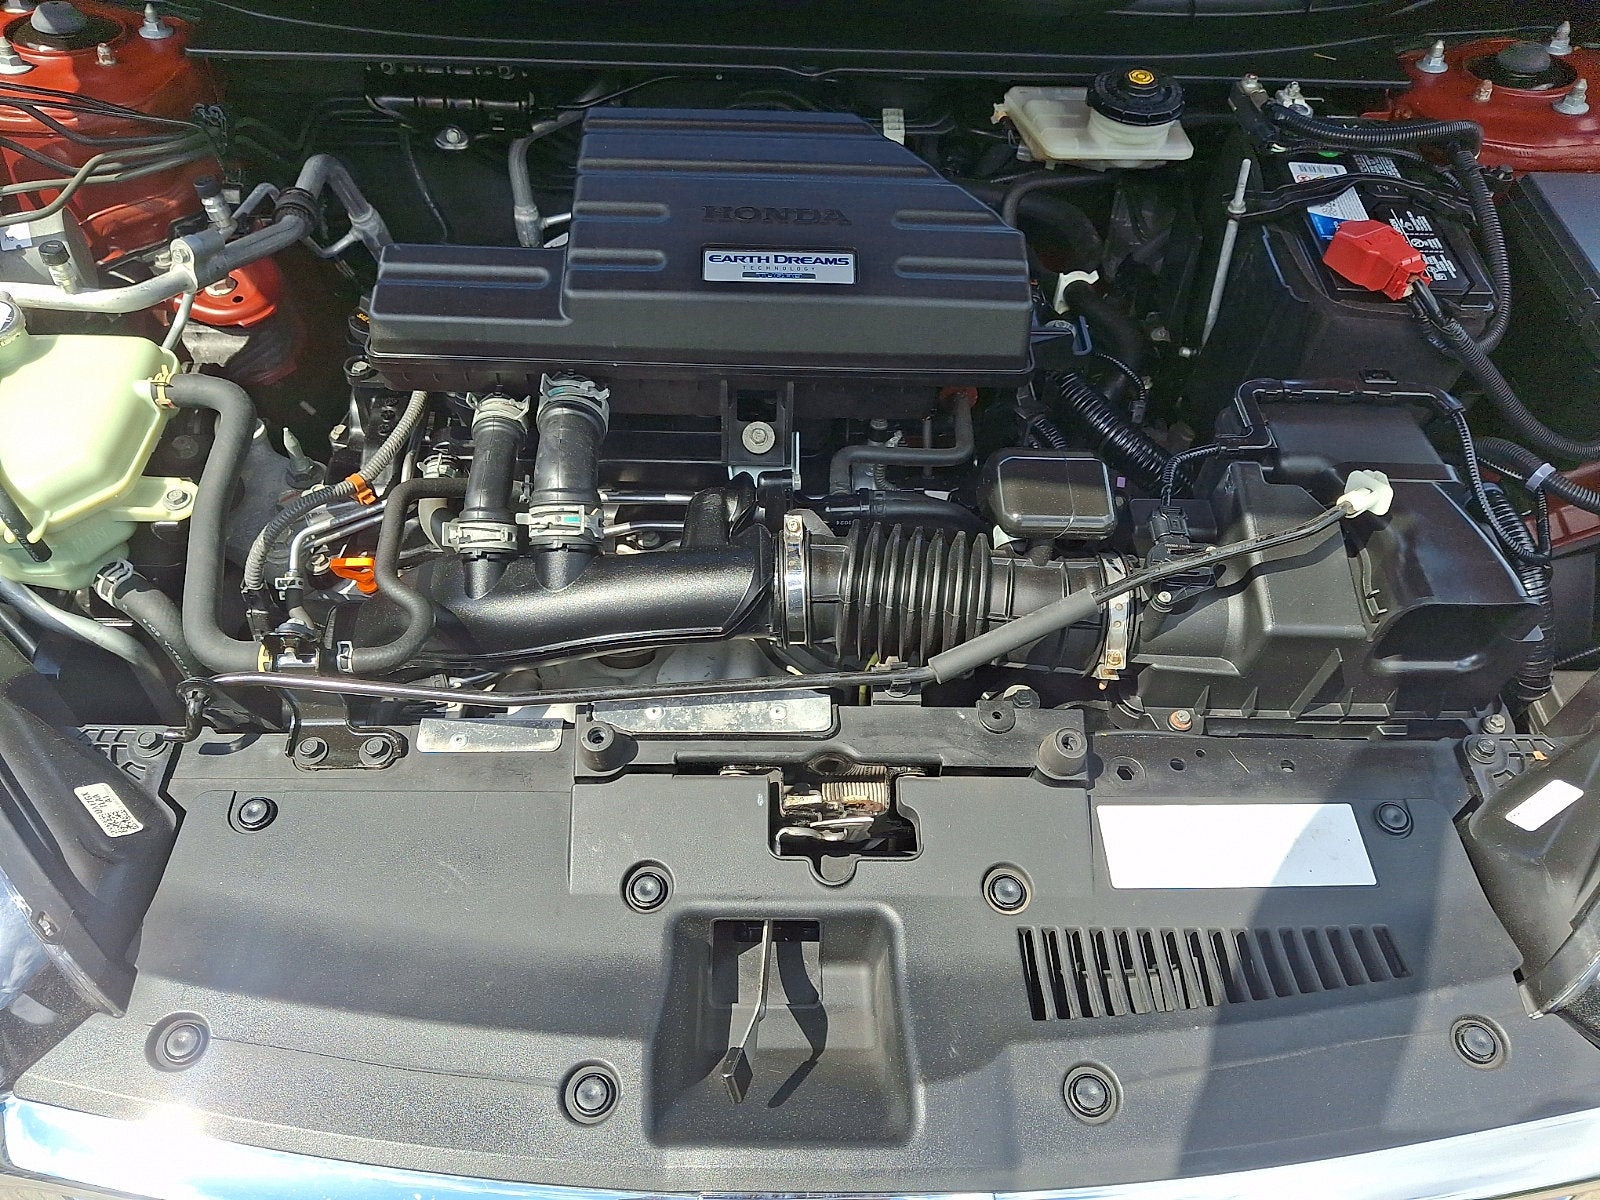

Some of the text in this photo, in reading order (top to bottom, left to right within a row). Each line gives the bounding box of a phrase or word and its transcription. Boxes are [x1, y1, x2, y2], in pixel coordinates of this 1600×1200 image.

[702, 205, 852, 225] HONDA
[708, 254, 850, 266] EARTH DREAMS
